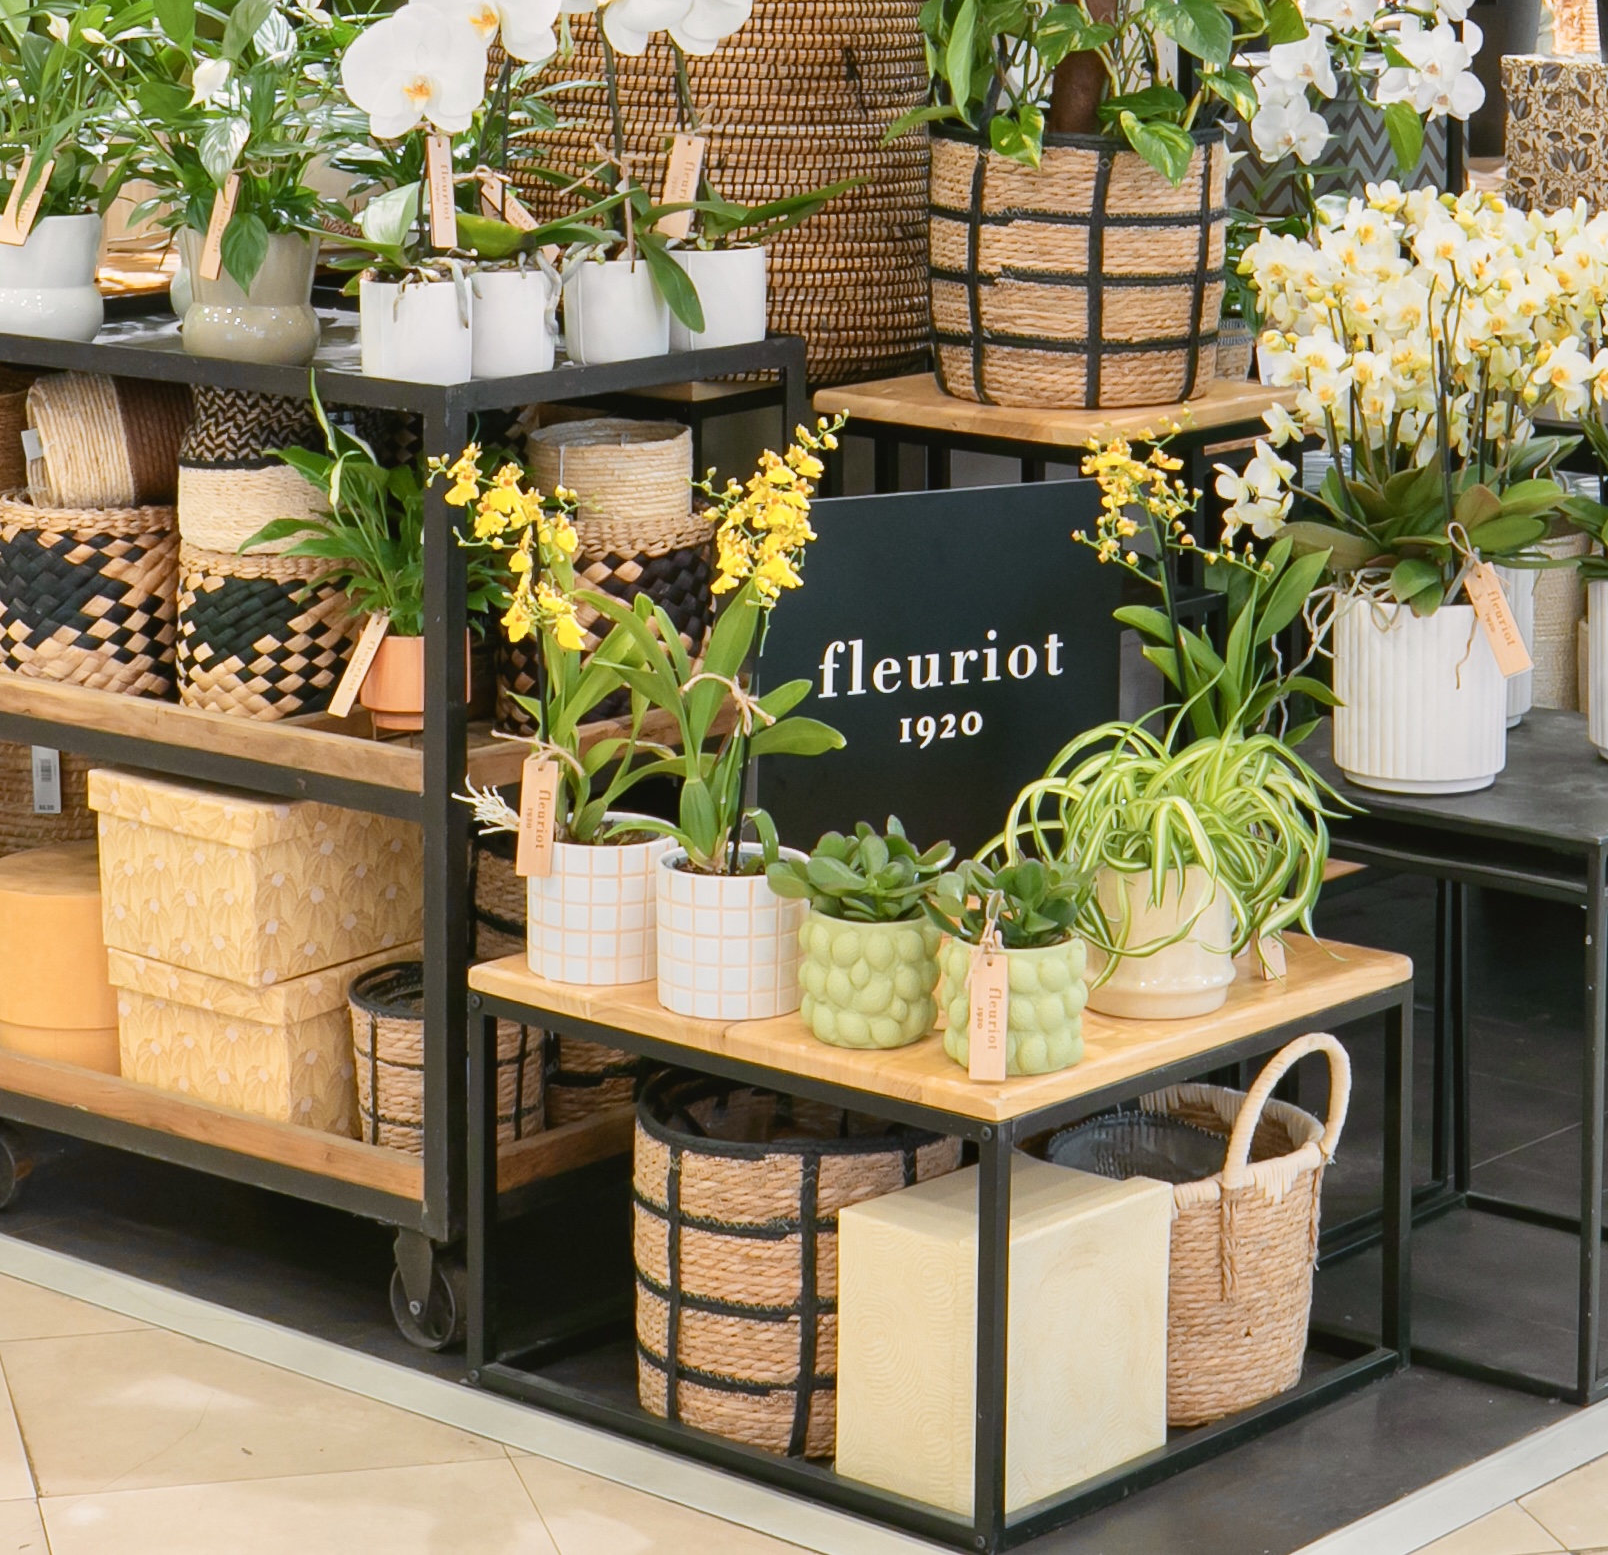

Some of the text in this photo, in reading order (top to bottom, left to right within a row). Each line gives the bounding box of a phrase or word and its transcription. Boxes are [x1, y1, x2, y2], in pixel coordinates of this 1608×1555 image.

[1487, 589, 1517, 647] fleuriot
[817, 629, 1065, 700] fleuriot
[898, 709, 984, 750] 1920
[535, 789, 552, 849] fleuriot
[987, 987, 1002, 1050] fleuriot
